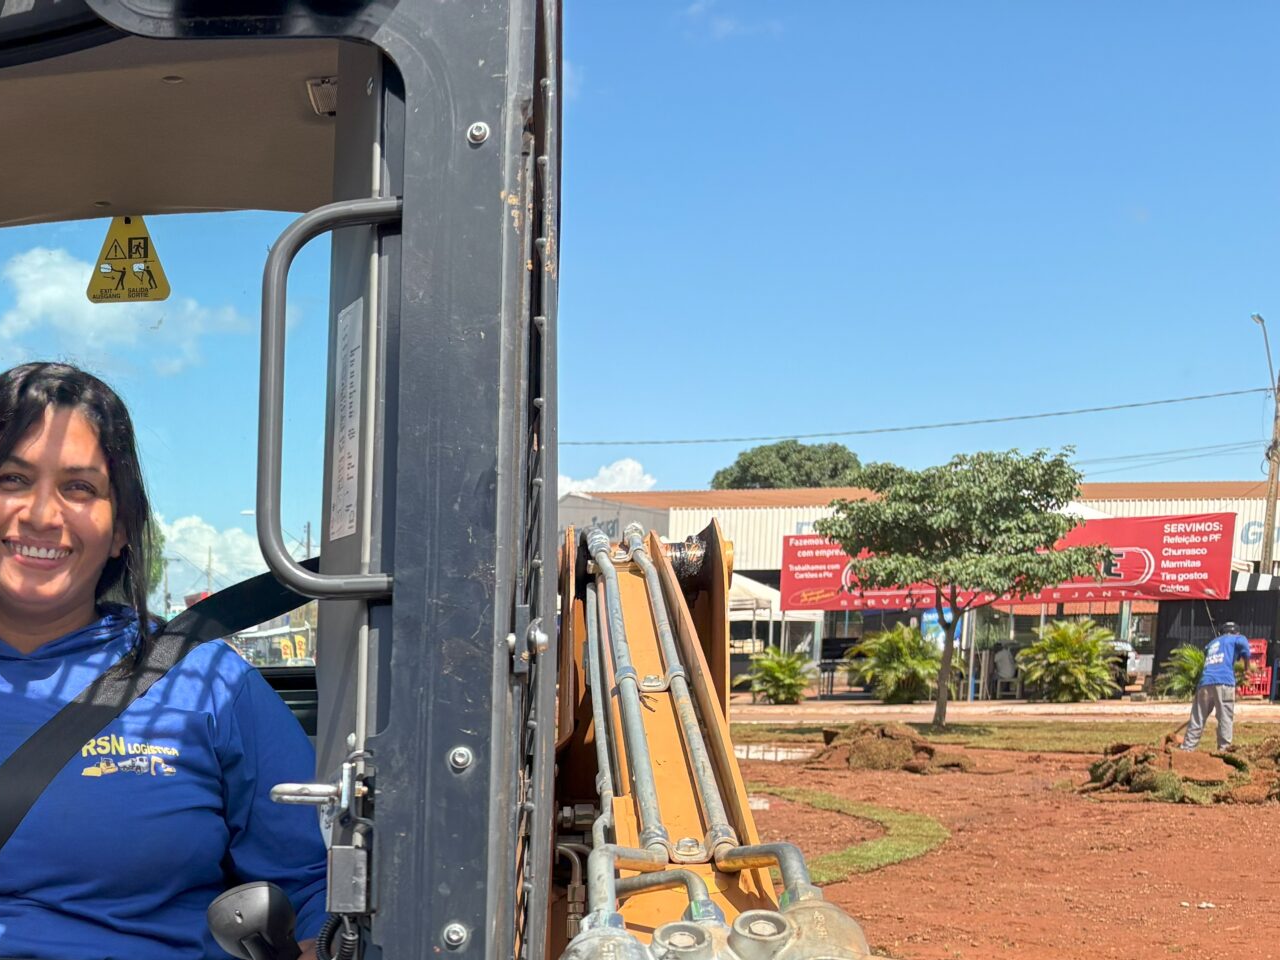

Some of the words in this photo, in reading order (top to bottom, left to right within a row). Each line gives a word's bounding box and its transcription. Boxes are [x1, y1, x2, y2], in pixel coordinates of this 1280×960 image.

[1163, 521, 1223, 533] SERVIMOS:
[1163, 535, 1201, 545] Refeição
[1209, 533, 1222, 542] PF
[1162, 547, 1207, 556] Churrasco
[1161, 559, 1201, 568] Marmitas
[1160, 572, 1177, 581] Tira
[1178, 572, 1208, 582] gostos
[81, 733, 126, 757] RSN
